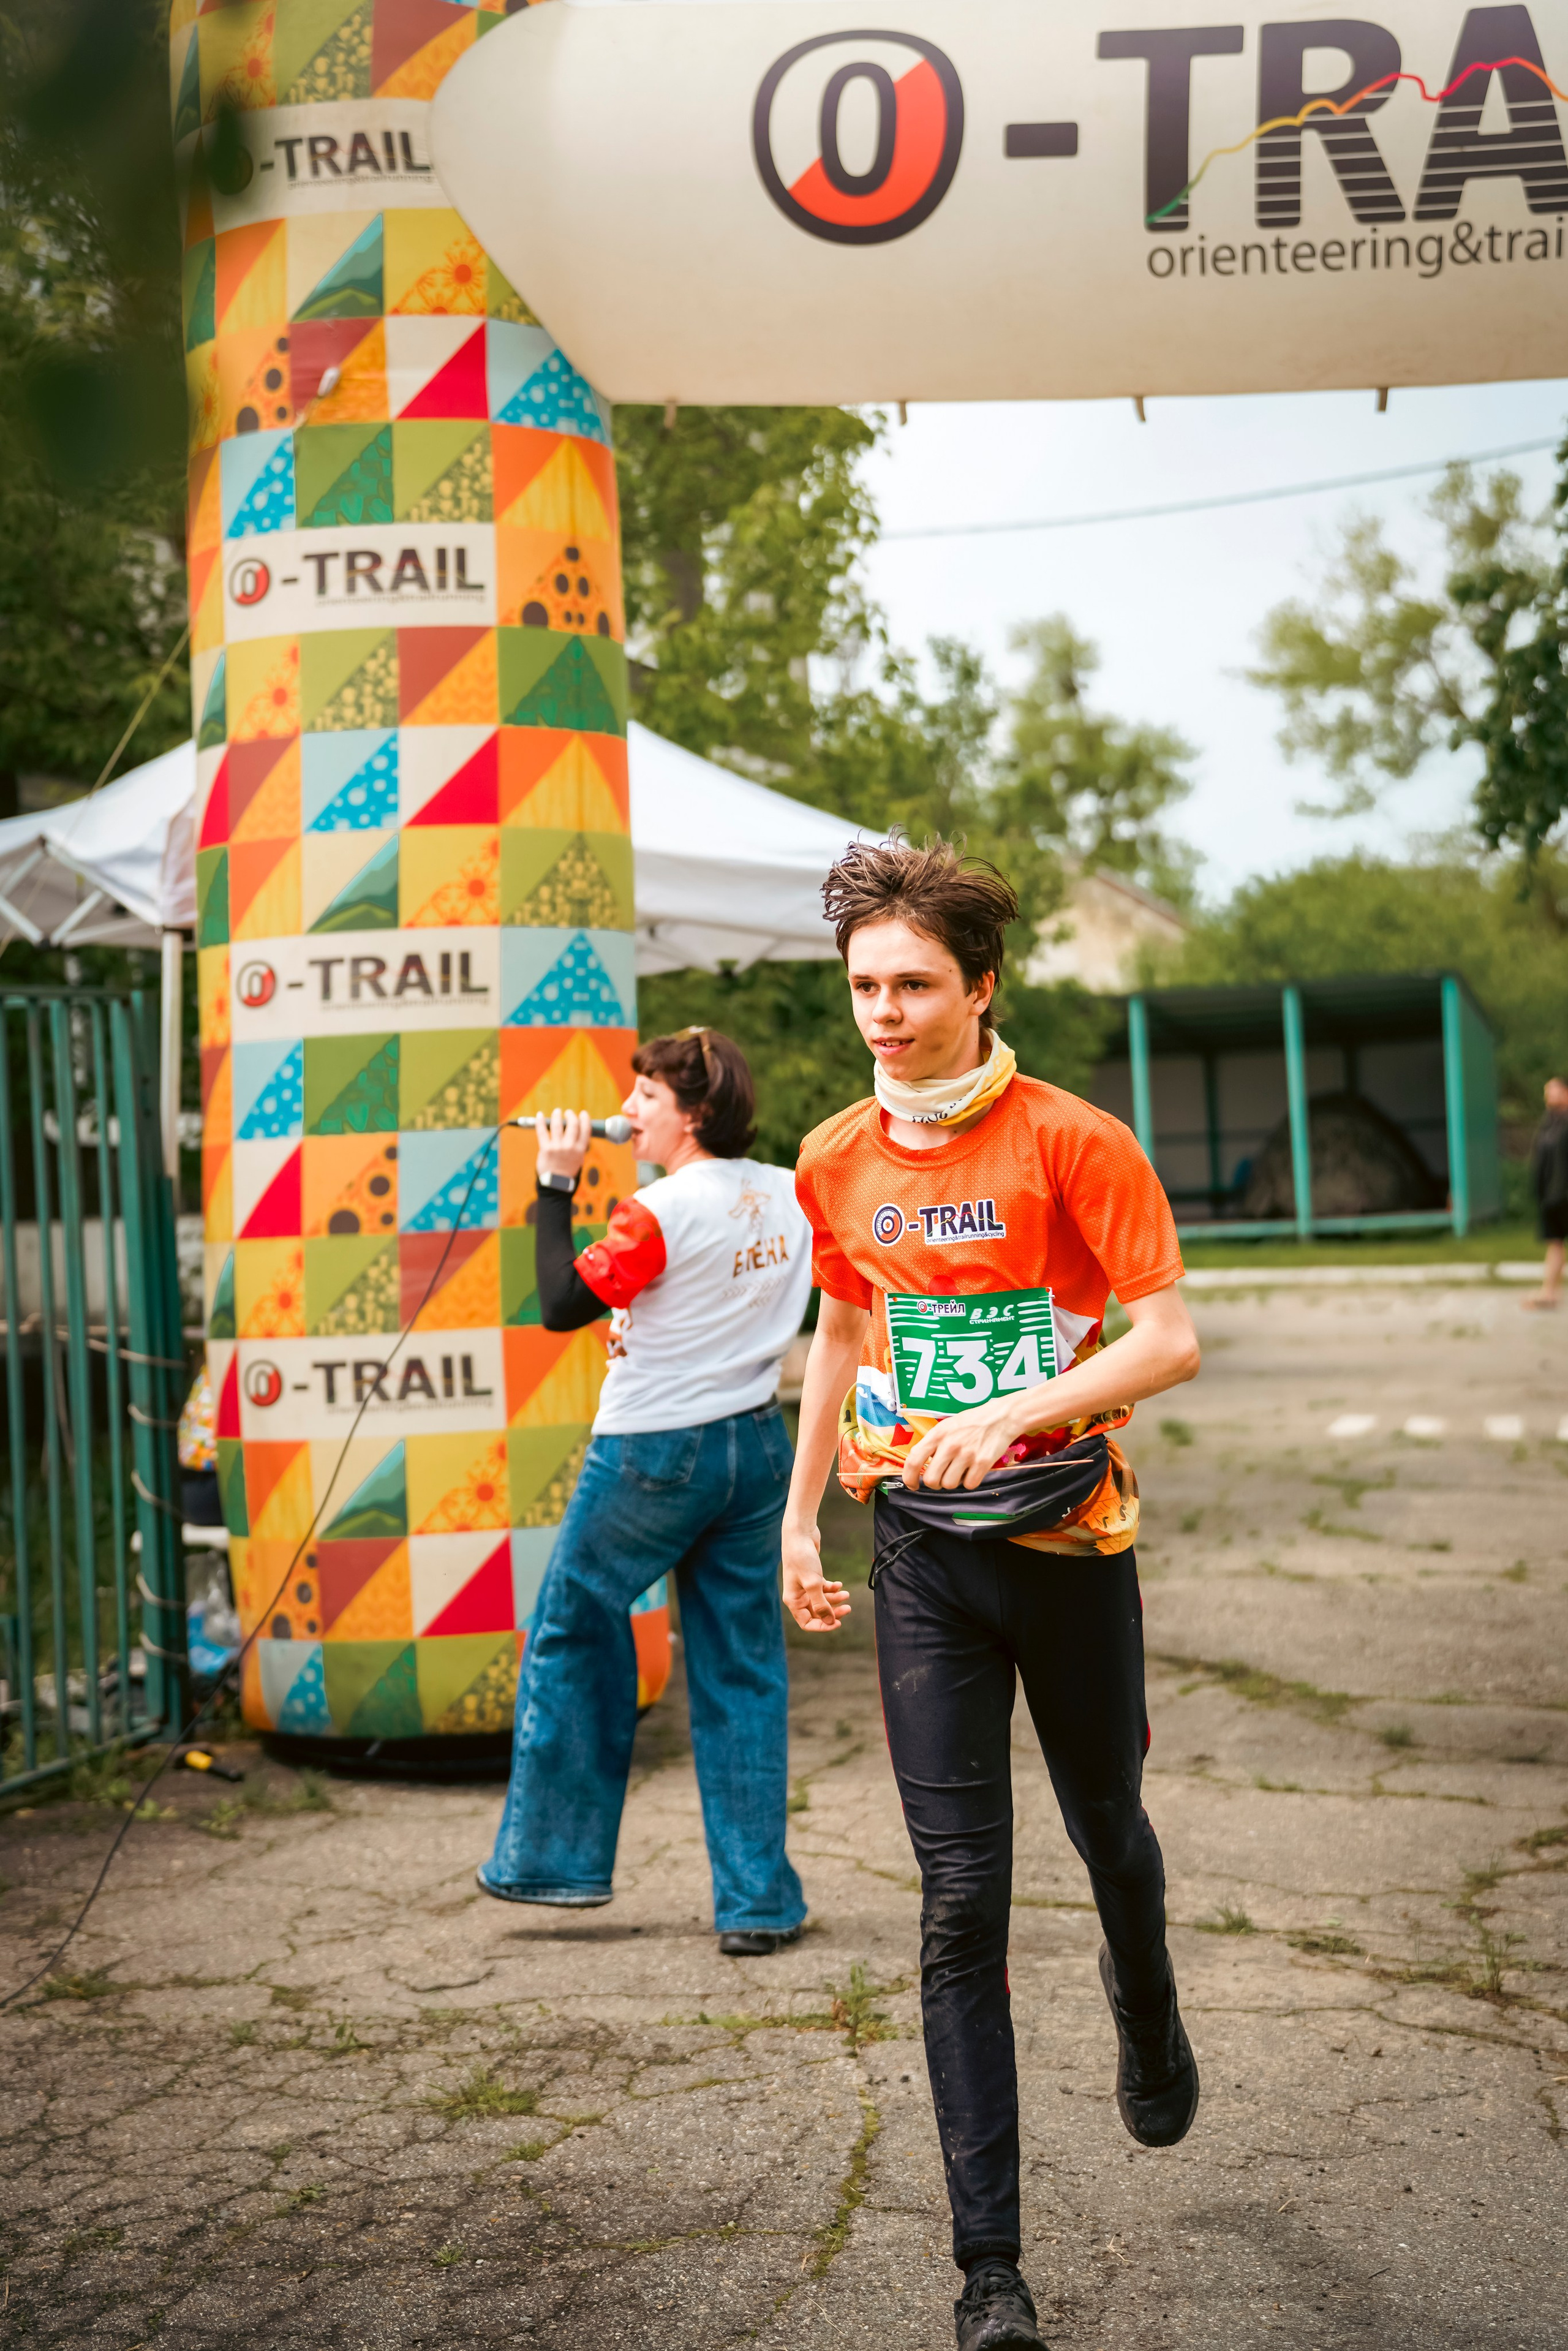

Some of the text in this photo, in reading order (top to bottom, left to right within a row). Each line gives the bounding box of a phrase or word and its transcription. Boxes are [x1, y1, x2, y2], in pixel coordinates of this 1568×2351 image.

[228, 547, 485, 606] O-TRAIL
[236, 951, 489, 1008] O-TRAIL
[874, 1200, 1003, 1244] O-TRAIL
[902, 1334, 1047, 1403] 734
